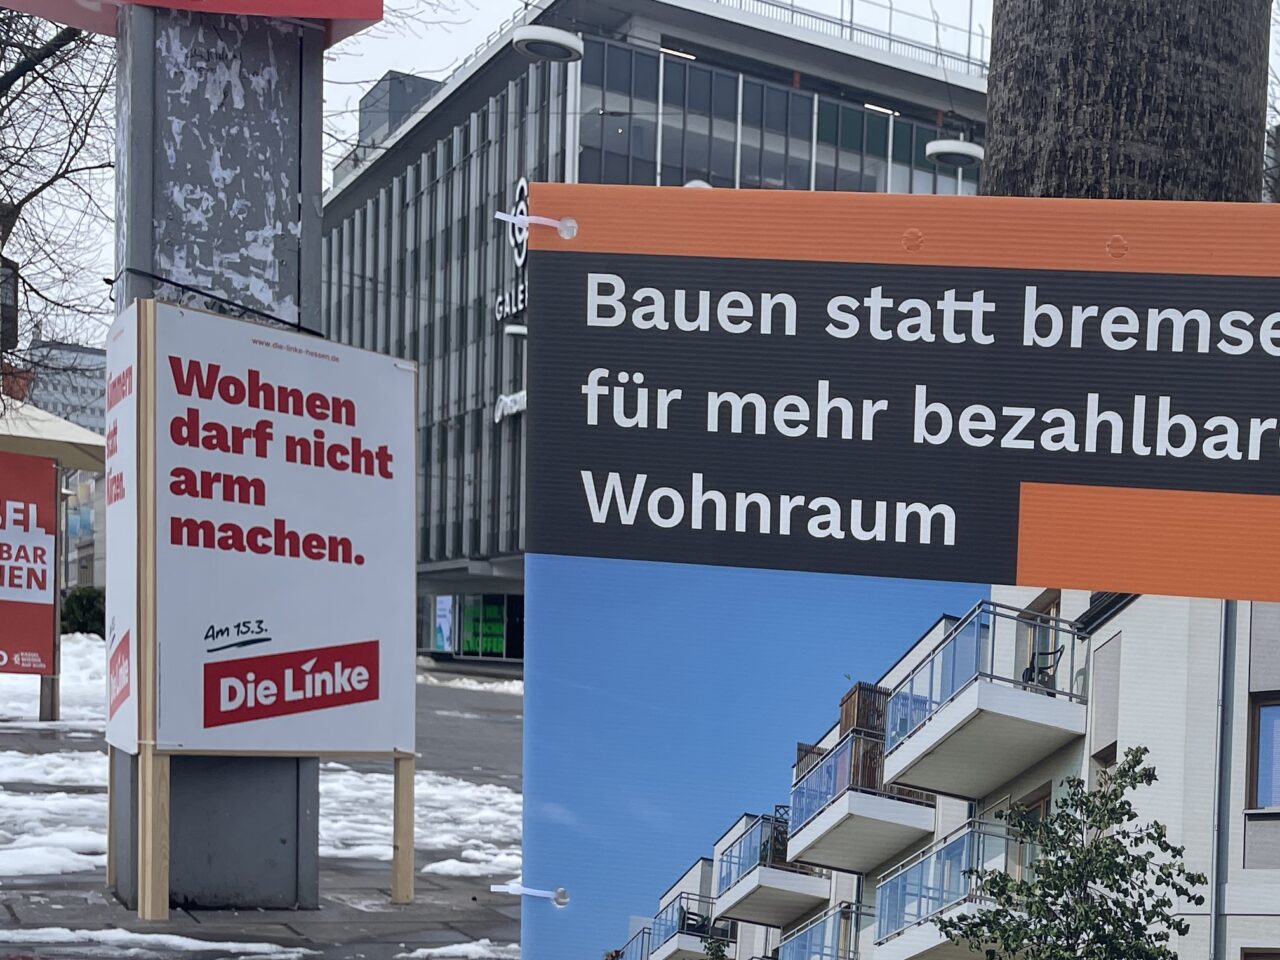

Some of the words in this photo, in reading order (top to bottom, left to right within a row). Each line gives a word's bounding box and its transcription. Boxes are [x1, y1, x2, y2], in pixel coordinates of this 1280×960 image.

[495, 281, 528, 321] GALE
[586, 273, 797, 336] Bauen
[825, 285, 996, 345] statt
[252, 337, 340, 363] www.die-linke-hessen.de
[169, 356, 355, 426] Wohnen
[581, 367, 683, 430] für
[707, 379, 889, 441] mehr
[170, 407, 273, 458] darf
[285, 429, 393, 479] nicht
[170, 467, 265, 506] arm
[580, 470, 956, 546] Wohnraum
[0, 500, 46, 534] EL
[170, 517, 364, 565] machen.
[204, 624, 230, 641] Am
[233, 619, 268, 637] 15.3.
[219, 672, 278, 713] Die
[284, 657, 369, 702] Linke
